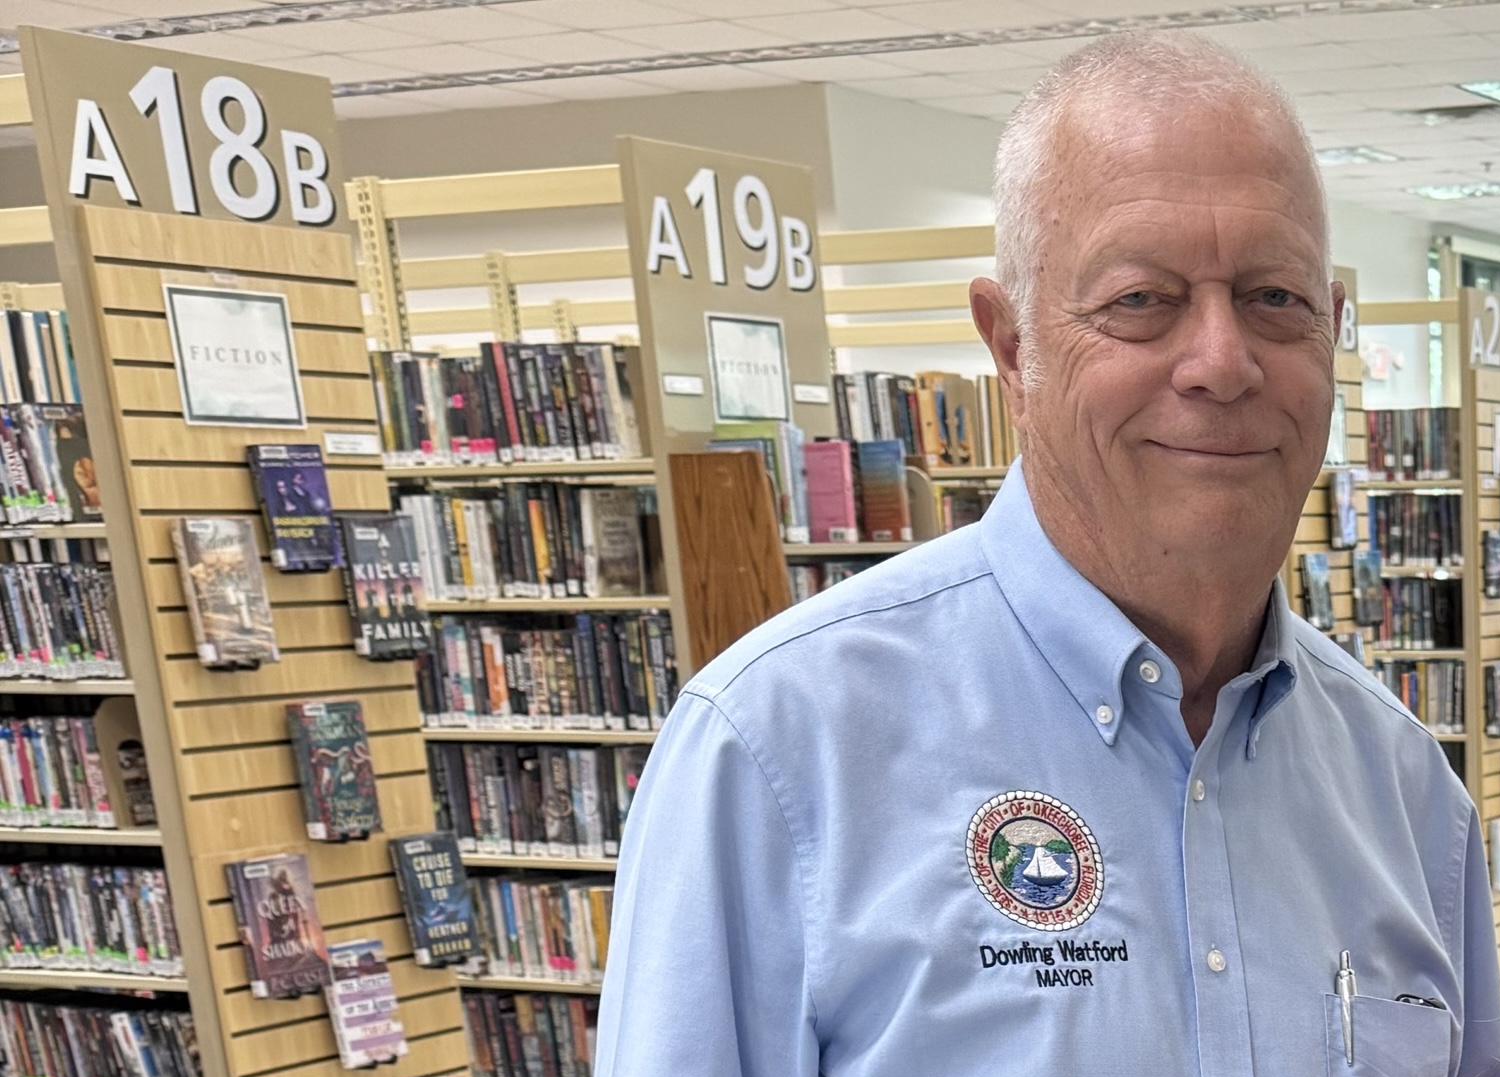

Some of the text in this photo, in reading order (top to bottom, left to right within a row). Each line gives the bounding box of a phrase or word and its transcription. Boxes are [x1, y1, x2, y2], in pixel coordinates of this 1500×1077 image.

[189, 345, 283, 365] FICTION
[353, 561, 421, 580] KILLER
[361, 620, 432, 640] FAMILY
[976, 833, 990, 853] THE
[984, 809, 1005, 831] CITY
[1008, 802, 1025, 817] OF
[1033, 803, 1090, 853] OKEECHOBEE
[412, 852, 452, 873] CRUISE
[1033, 910, 1065, 923] 1915
[979, 939, 1129, 968] Dowling Watford
[1035, 969, 1094, 988] MAYOR
